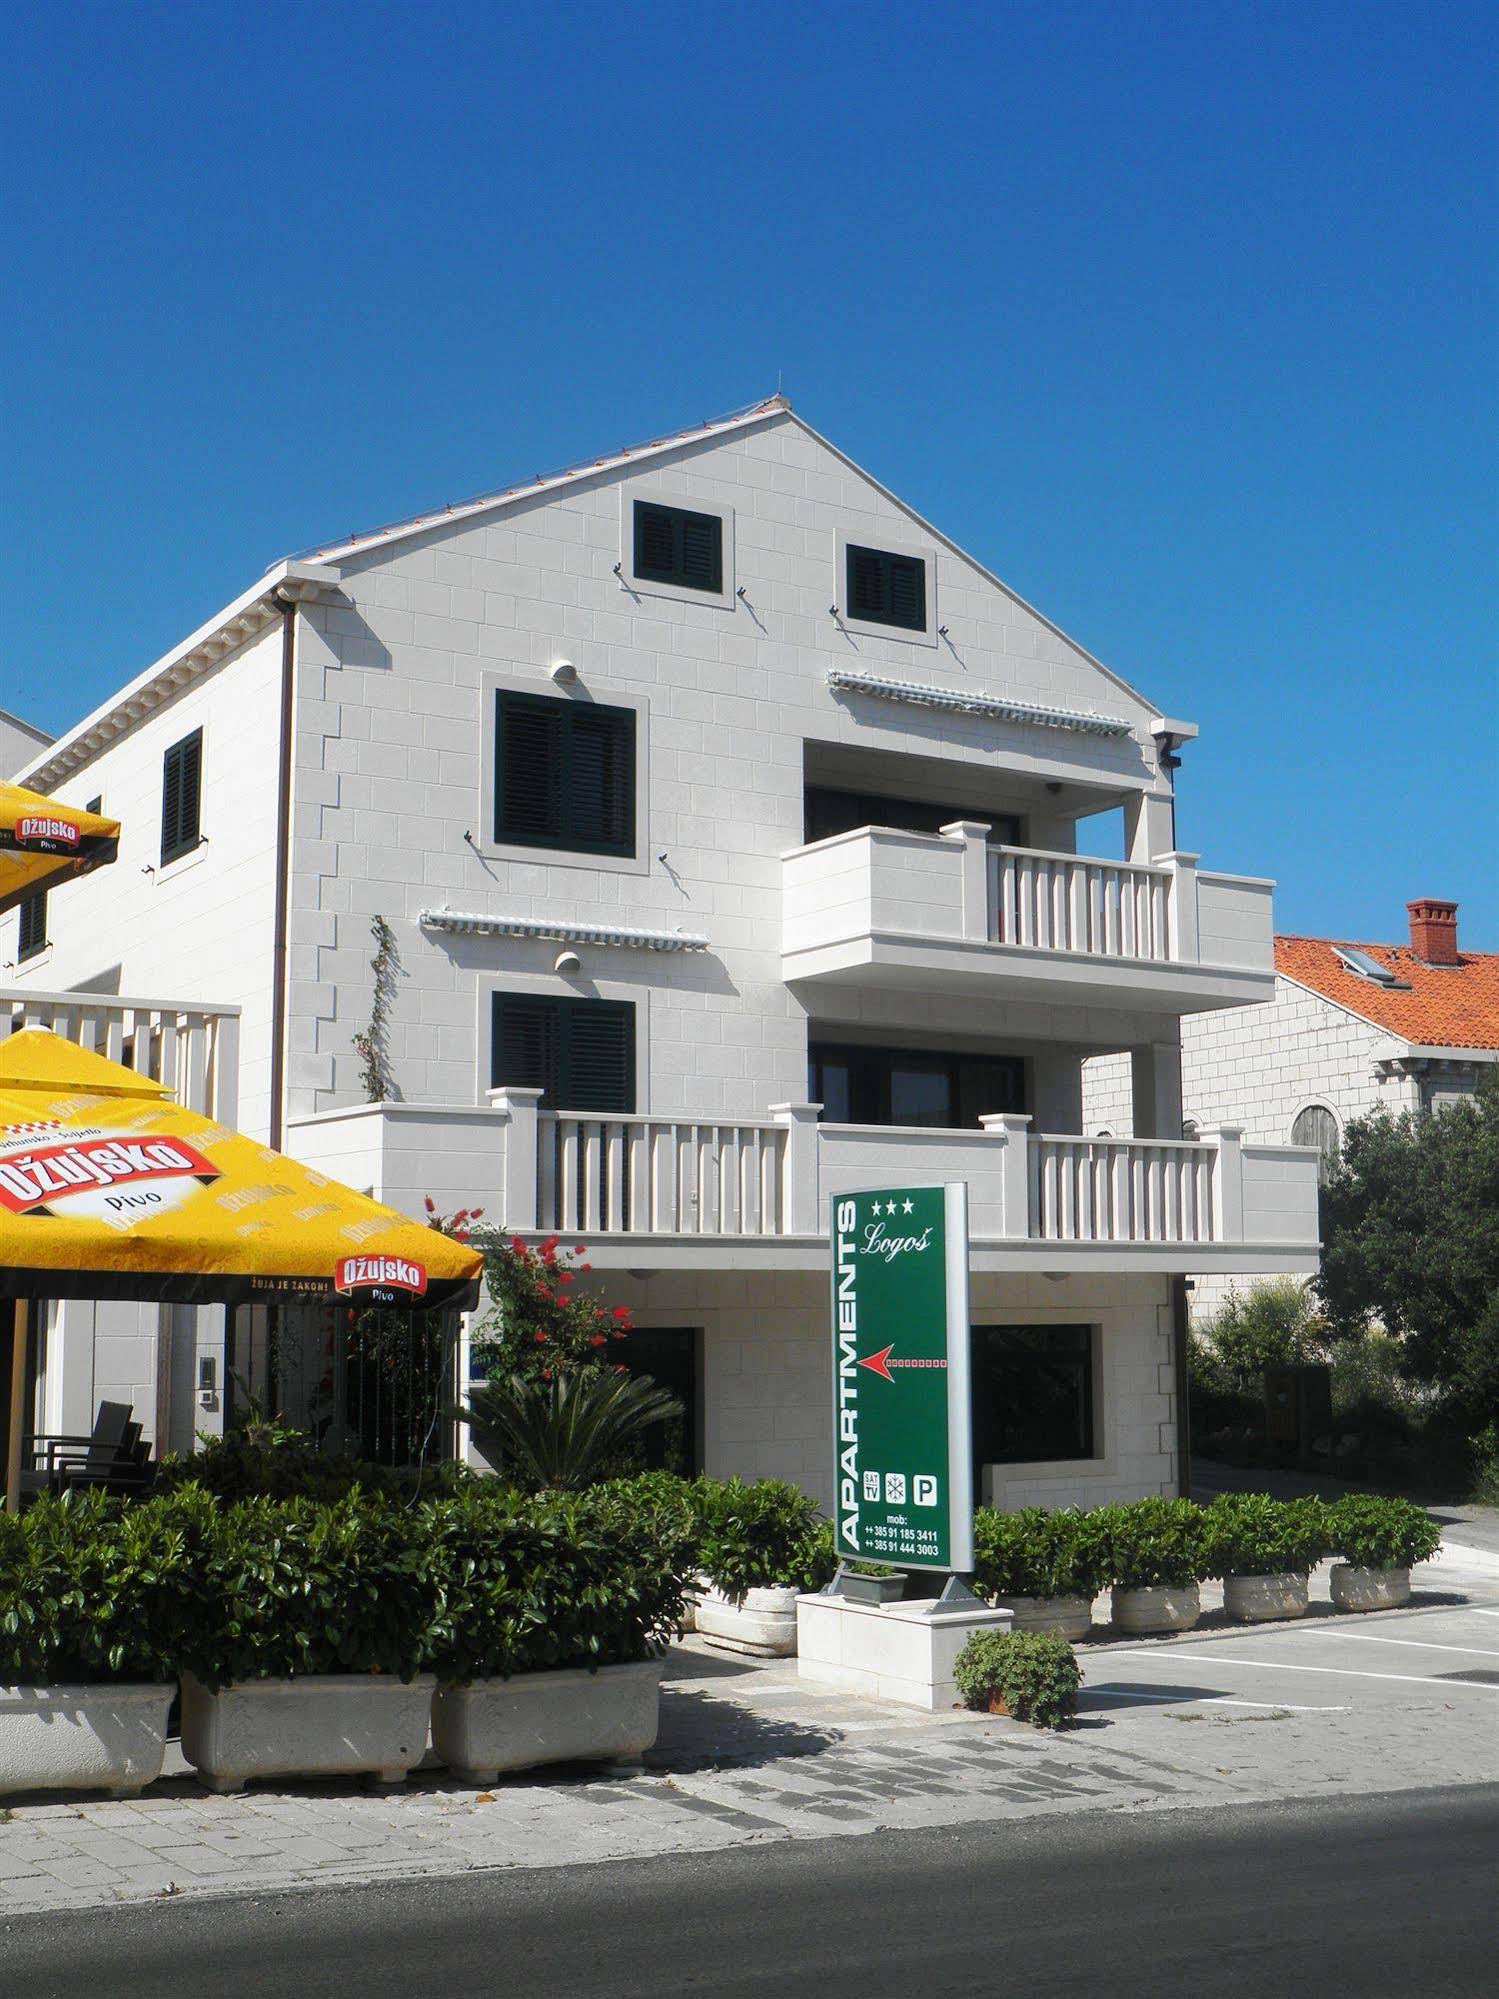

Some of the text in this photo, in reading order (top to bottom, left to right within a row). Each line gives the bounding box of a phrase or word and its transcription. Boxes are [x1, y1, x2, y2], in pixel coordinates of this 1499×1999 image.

[21, 818, 76, 840] Ožujsko
[0, 1142, 194, 1201] Ožujsko
[343, 1256, 420, 1287] Ožujsko
[251, 1276, 328, 1292] ŽUJA JE ZAKON!
[372, 1288, 394, 1301] Pivo
[837, 1199, 860, 1551] APARTMENTS
[865, 1473, 878, 1483] SAT
[866, 1487, 878, 1498] TV
[920, 1480, 933, 1502] P
[887, 1514, 908, 1525] mob:
[888, 1527, 898, 1538] 91
[900, 1528, 915, 1540] 185
[917, 1530, 938, 1542] 3411
[888, 1541, 898, 1552] 91
[899, 1543, 915, 1554] 444
[917, 1544, 939, 1556] 3003
